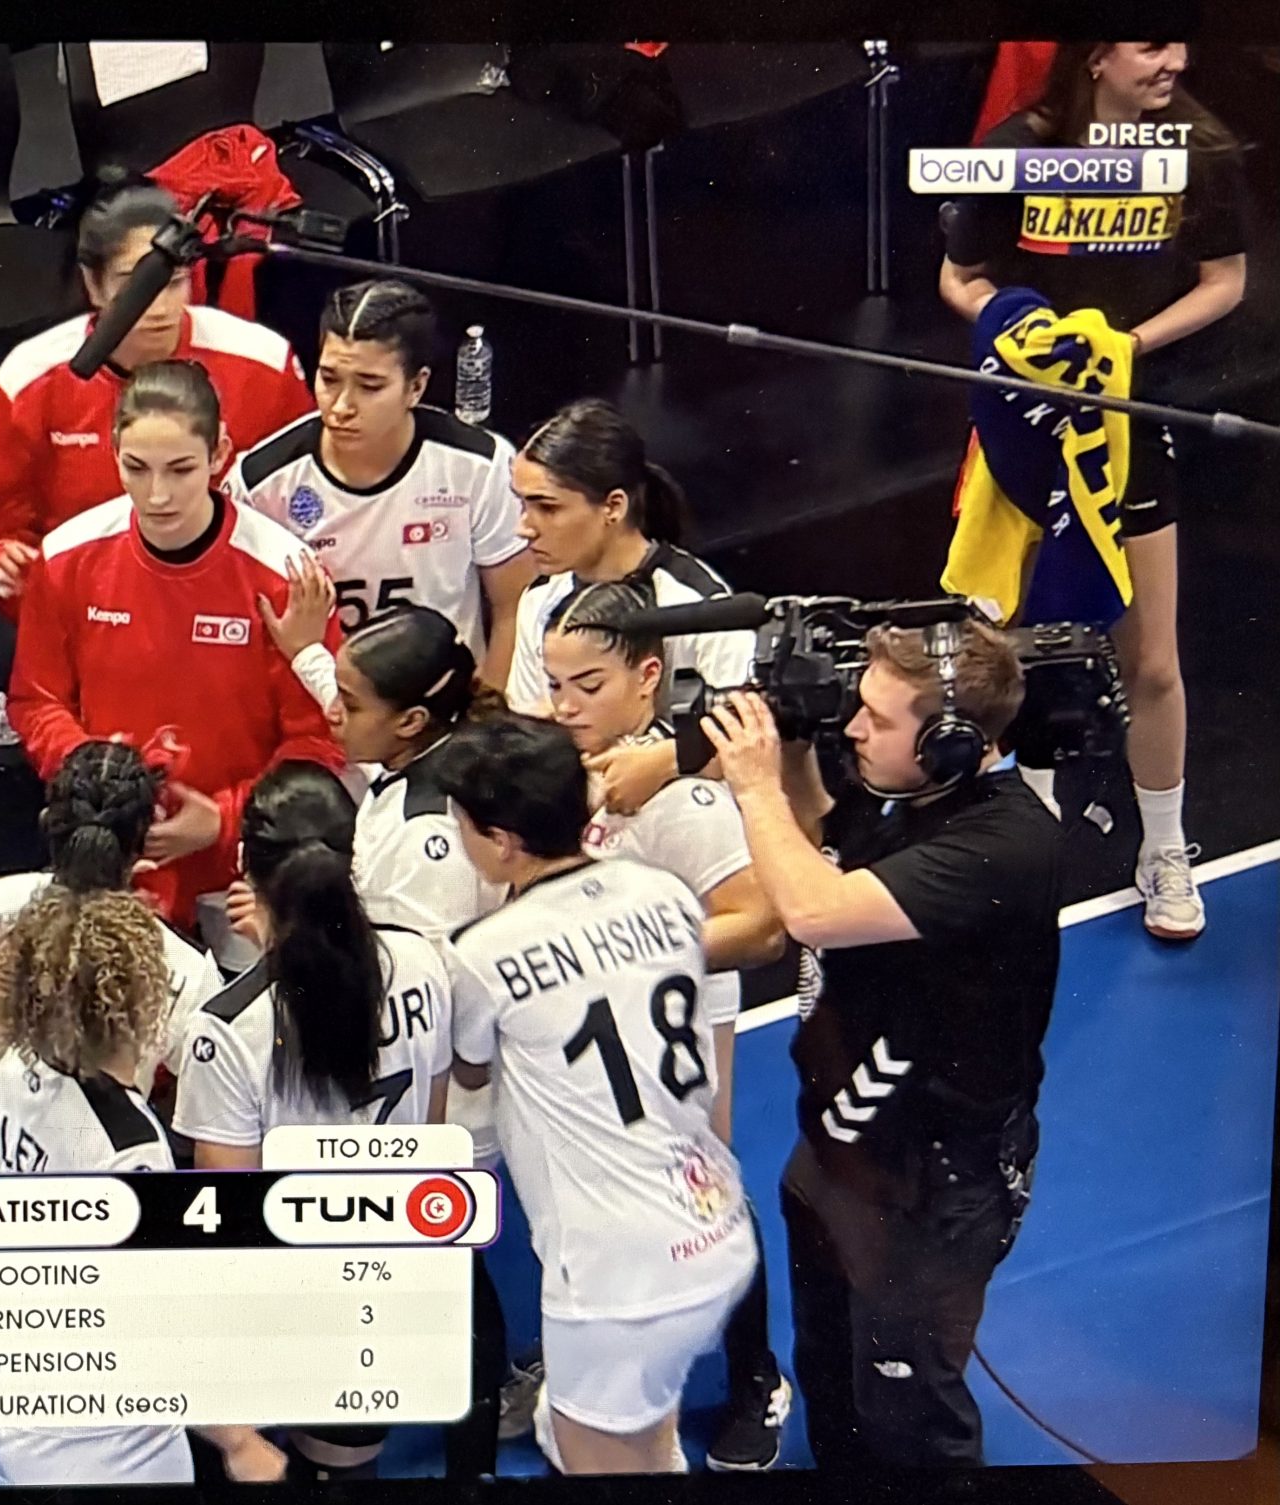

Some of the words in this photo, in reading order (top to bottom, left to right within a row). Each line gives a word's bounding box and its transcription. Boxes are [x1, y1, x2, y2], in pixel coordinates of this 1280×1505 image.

[1088, 122, 1193, 147] DIRECT
[919, 153, 1005, 183] beIN
[1024, 157, 1134, 184] SPORTS
[1158, 157, 1169, 185] 1
[87, 606, 131, 627] Kempa
[496, 936, 586, 1001] BEN
[562, 973, 709, 1128] 18
[316, 1138, 360, 1159] TTO
[368, 1137, 419, 1159] 0:29
[183, 1186, 222, 1234] 4
[281, 1196, 394, 1223] TUN
[342, 1261, 392, 1282] 57%
[360, 1304, 375, 1325] 3
[359, 1347, 375, 1368] 0
[115, 1393, 188, 1418] (secs)
[334, 1389, 399, 1413] 40,90
